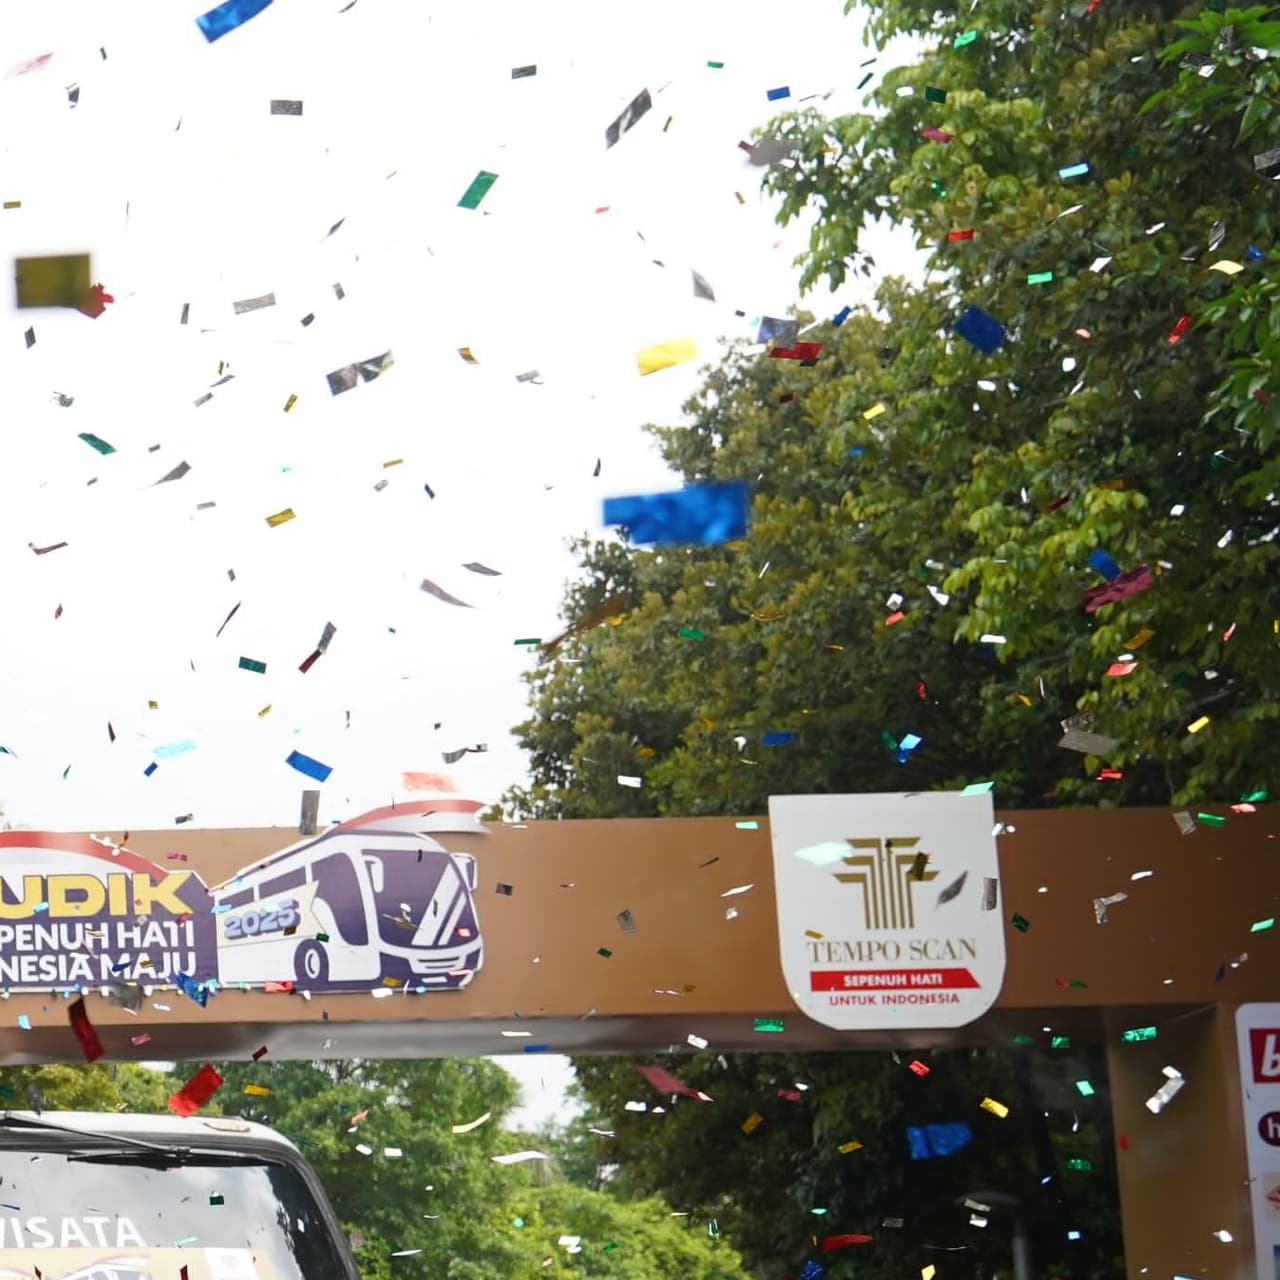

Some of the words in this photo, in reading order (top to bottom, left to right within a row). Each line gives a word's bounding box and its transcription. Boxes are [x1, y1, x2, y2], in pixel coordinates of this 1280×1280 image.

[224, 899, 300, 939] 2025
[117, 920, 194, 949] HATI
[806, 939, 900, 963] TEMPO
[910, 937, 977, 962] SCAN
[102, 951, 197, 981] MAJU
[844, 974, 906, 987] SEPENUH
[911, 973, 942, 985] HATI
[830, 994, 876, 1006] UNTUK
[882, 993, 960, 1005] INDONESIA
